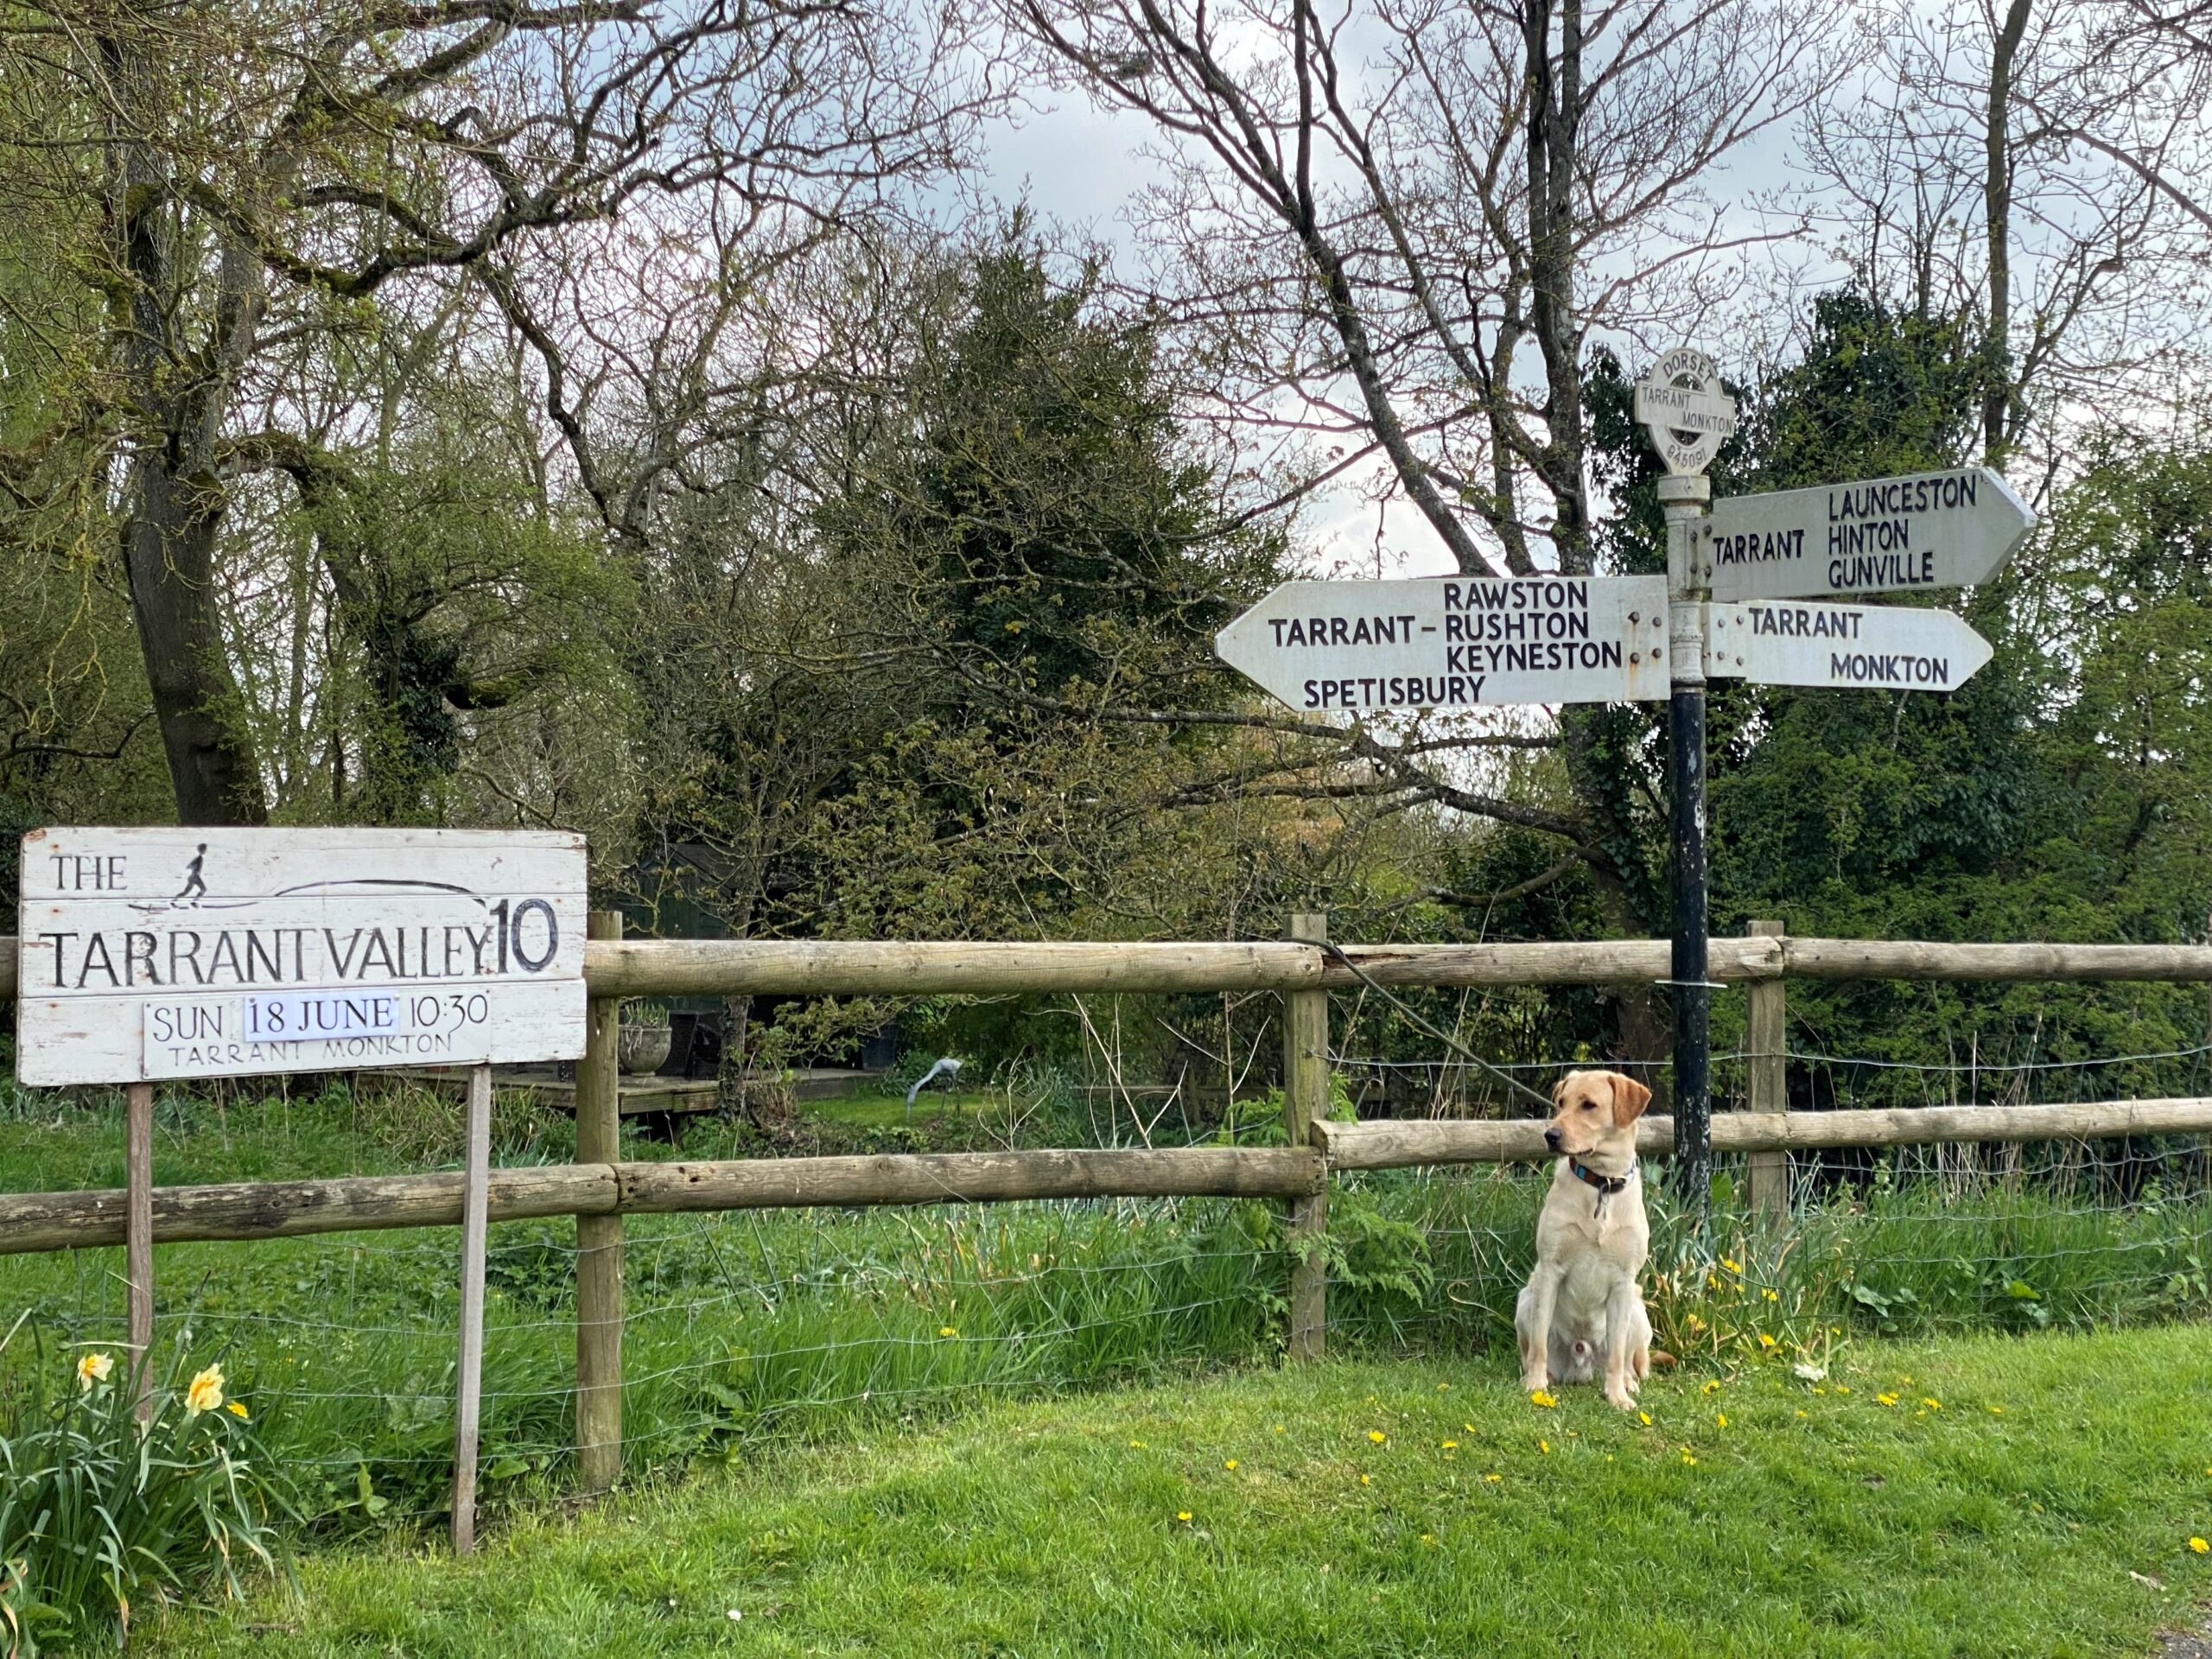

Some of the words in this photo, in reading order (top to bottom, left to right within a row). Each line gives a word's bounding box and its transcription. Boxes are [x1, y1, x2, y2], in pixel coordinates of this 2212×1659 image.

[1663, 353, 1714, 384] DORSET
[1643, 386, 1691, 410] TARRANT
[1682, 411, 1733, 432] MONKTON
[1828, 474, 1976, 521] LAUNCESTON
[1713, 529, 1805, 565] TARRANT
[1828, 519, 1909, 556] HINTON
[1828, 551, 1935, 589] GUNVILLE
[1444, 581, 1587, 611] RAWSTON
[1268, 615, 1415, 647] TARRANT
[1446, 611, 1588, 642] RUSHTON
[1749, 607, 1863, 639] TARRANT
[1446, 640, 1622, 673] KEYNESTON
[1831, 653, 1948, 684] MONKTON
[1303, 675, 1486, 709] SPETISBURY
[49, 855, 128, 891] THE
[38, 928, 316, 989] TARRANT
[321, 926, 494, 979] VALLEY
[490, 899, 558, 973] 10
[153, 1006, 222, 1042] SUN
[249, 1001, 285, 1033] 18
[298, 998, 393, 1032] JUNE
[411, 995, 487, 1033] 10:30
[168, 1040, 303, 1067] TARRANT
[322, 1033, 451, 1059] MONKTON
